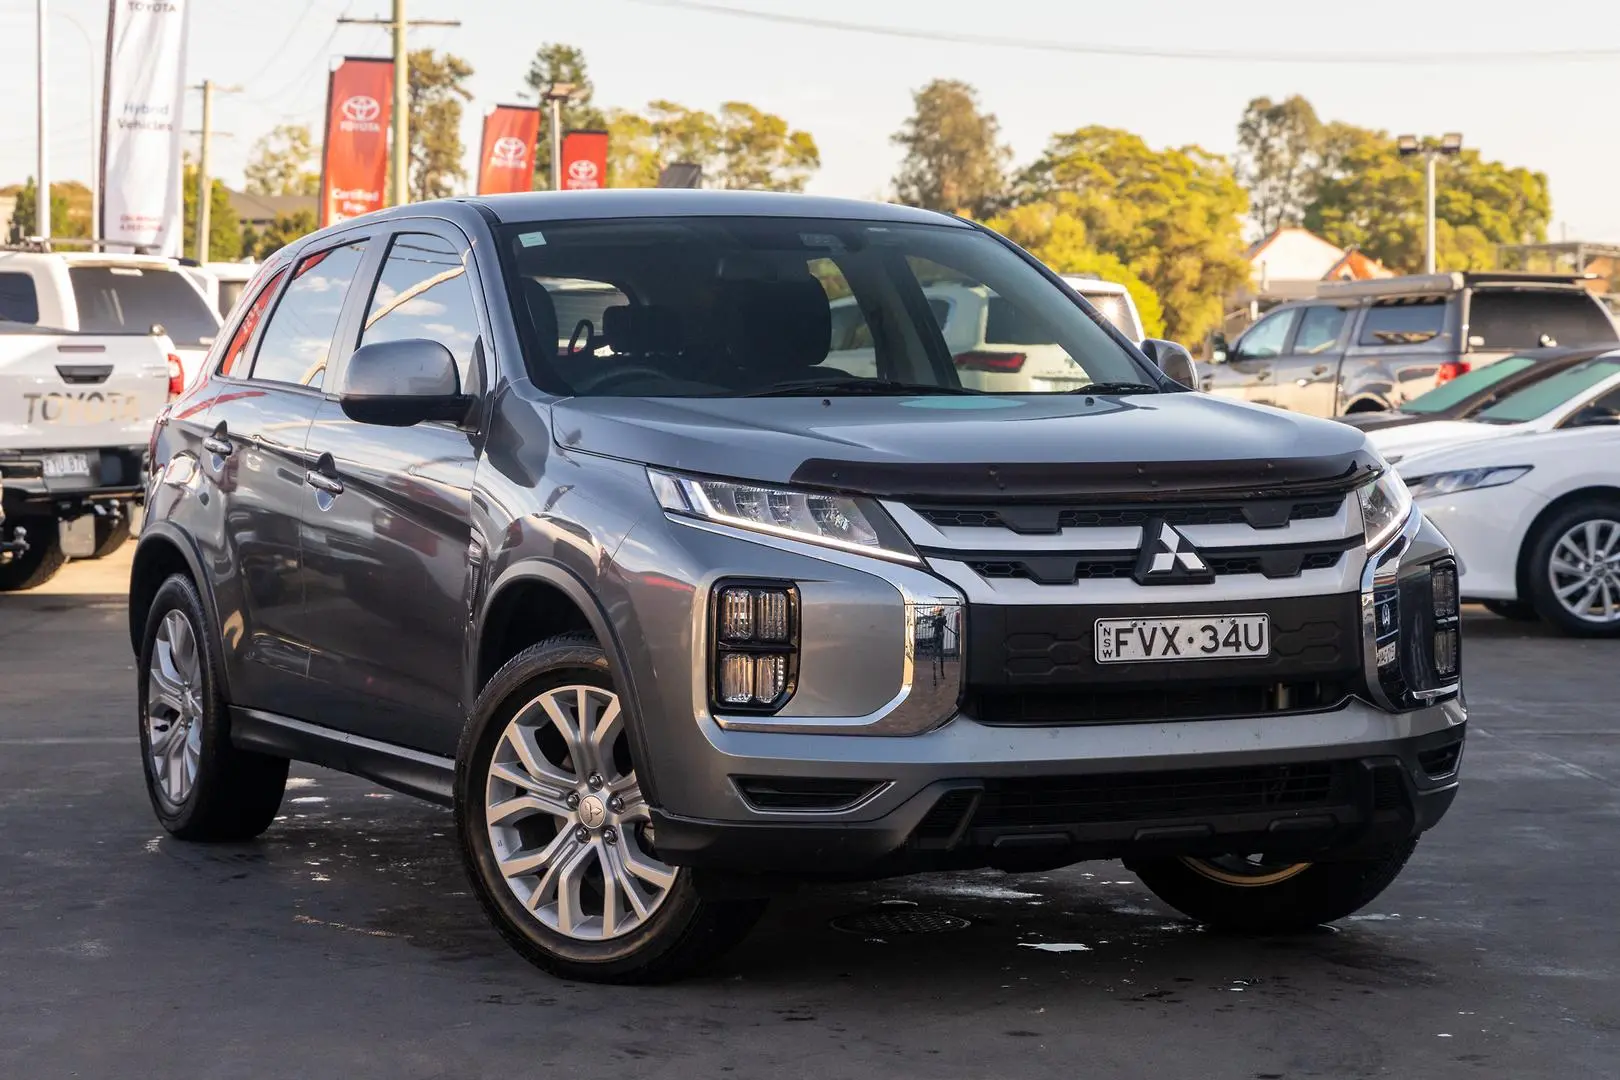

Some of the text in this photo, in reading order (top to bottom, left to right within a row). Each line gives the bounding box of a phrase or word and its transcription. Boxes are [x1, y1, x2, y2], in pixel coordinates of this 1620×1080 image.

[128, 1, 177, 13] TOYOTA
[123, 102, 169, 117] Hybrid
[117, 118, 174, 132] Vehicles
[339, 120, 381, 132] TOYOTA
[490, 156, 527, 169] TOYOTA
[23, 390, 142, 424] TOYOTA
[1103, 627, 1113, 659] NSW
